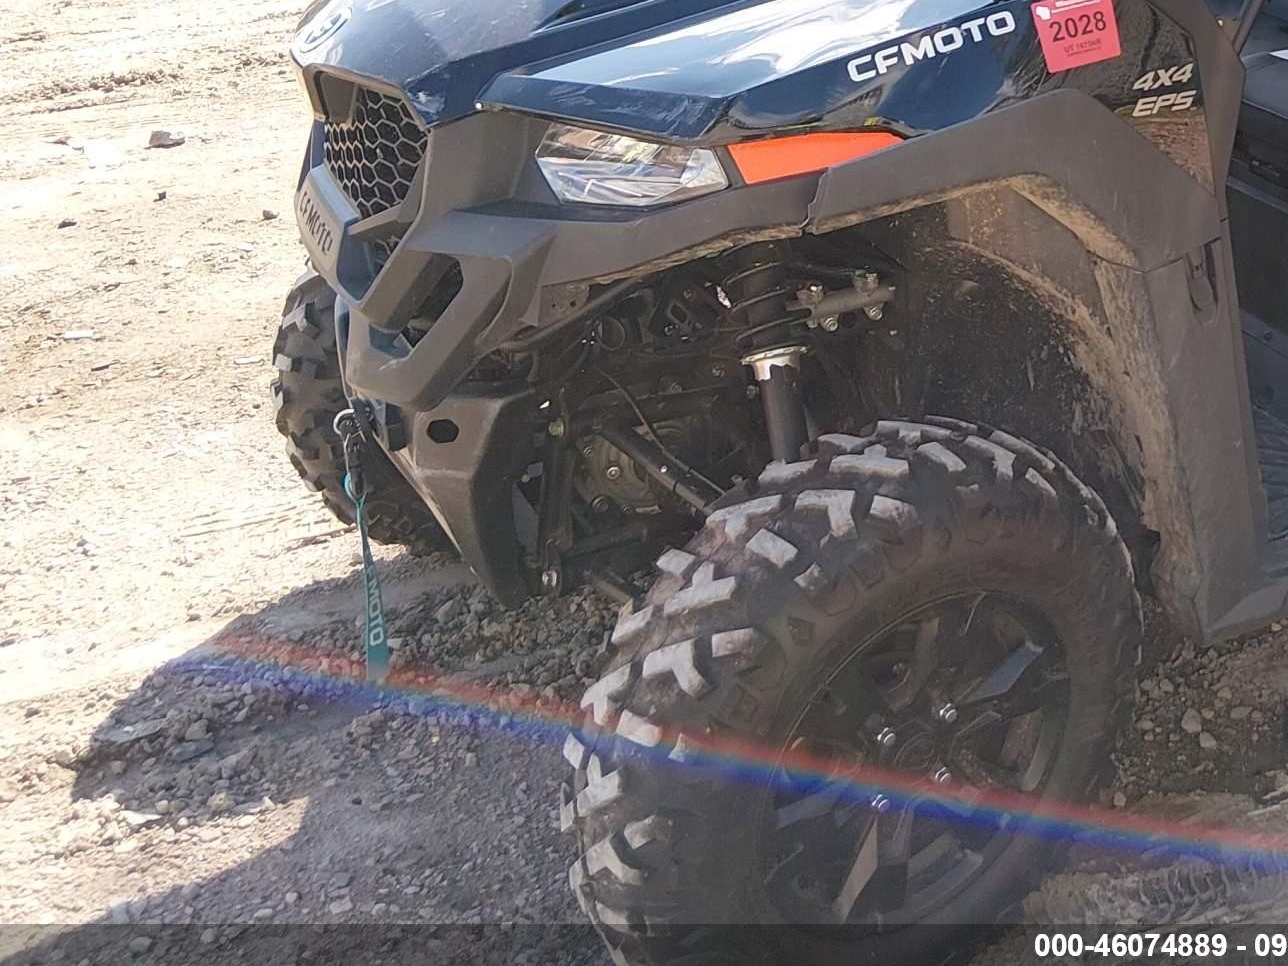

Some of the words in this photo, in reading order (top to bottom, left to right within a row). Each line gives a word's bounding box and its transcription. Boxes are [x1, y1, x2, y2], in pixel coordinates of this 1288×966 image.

[1048, 11, 1107, 43] 2028
[847, 10, 1016, 83] CFMOTO
[1132, 62, 1194, 92] 4X4
[1131, 90, 1196, 118] EPS
[300, 191, 334, 255] CFMOTO
